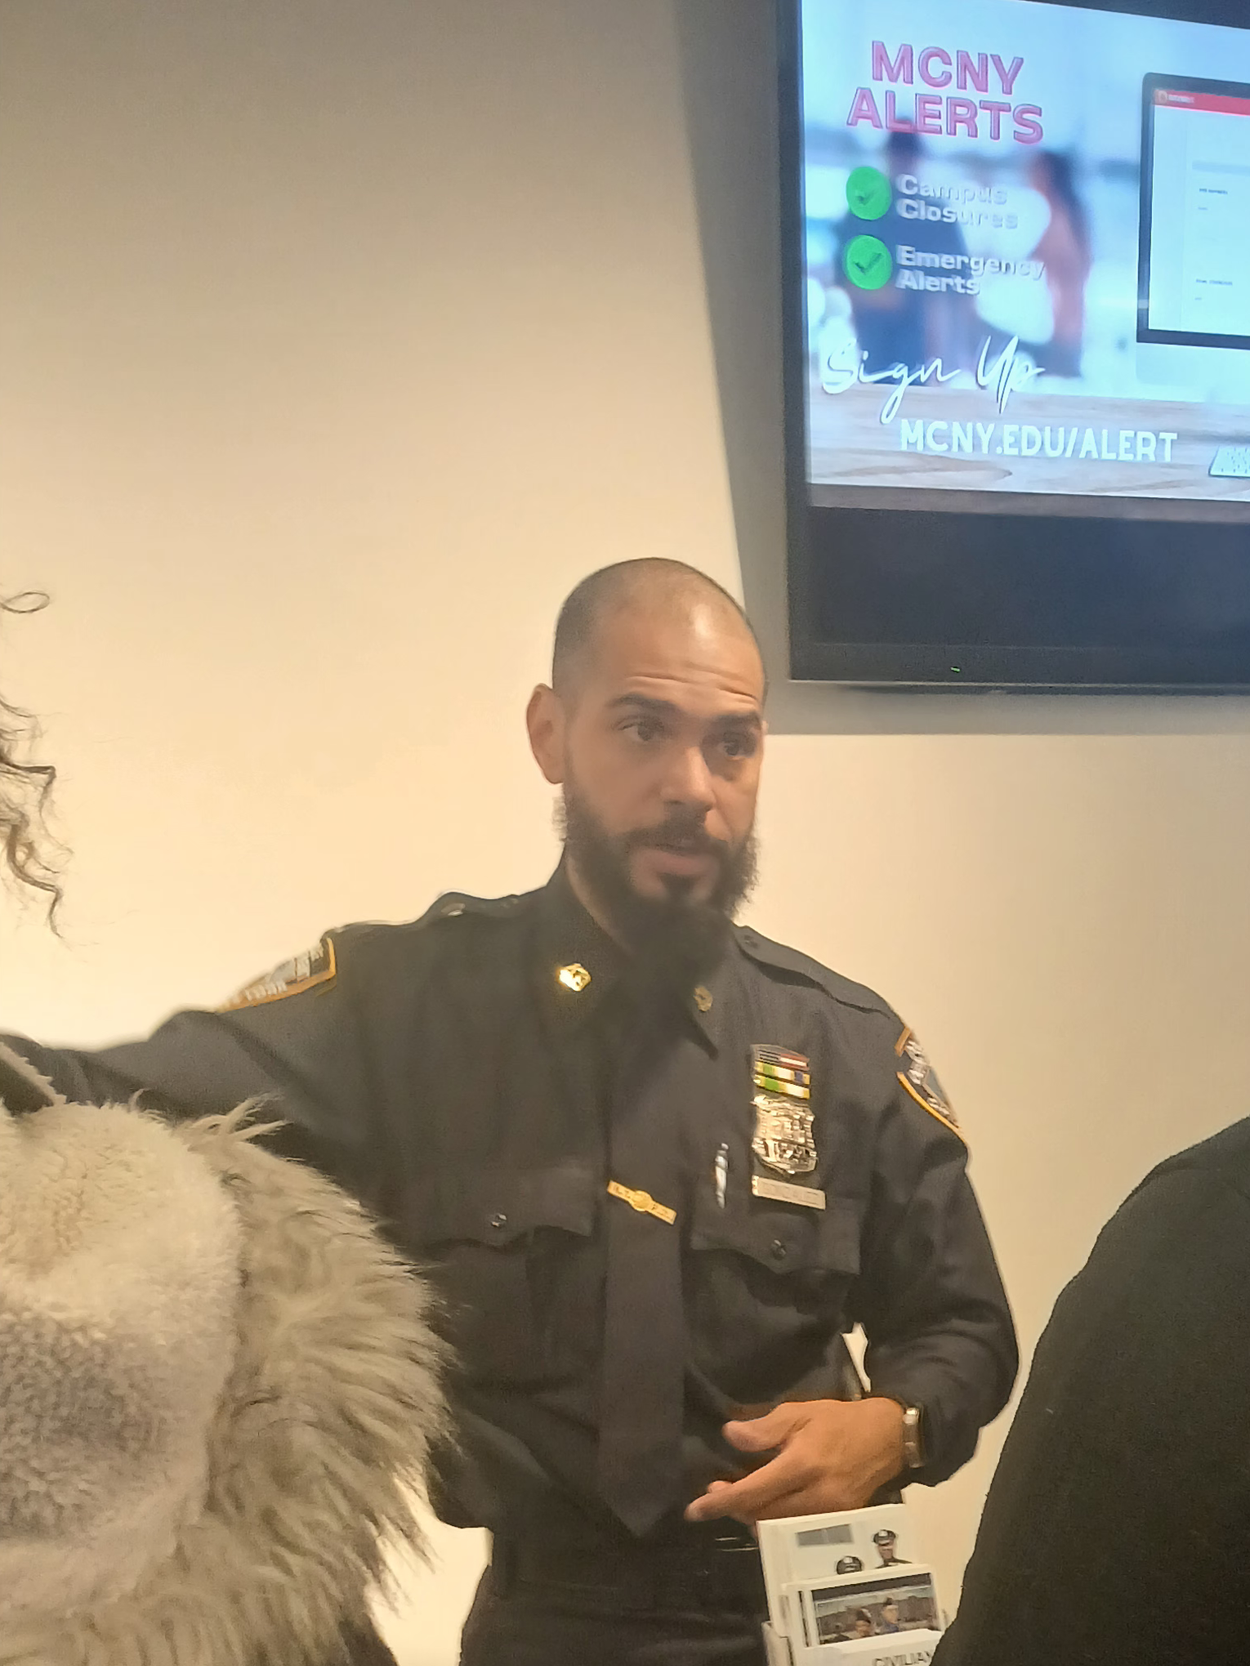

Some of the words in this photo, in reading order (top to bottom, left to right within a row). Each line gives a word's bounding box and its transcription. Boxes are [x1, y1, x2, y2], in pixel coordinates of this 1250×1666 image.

[871, 40, 1024, 96] MCNY
[847, 87, 1044, 145] ALERTS
[896, 173, 1008, 206] Campus
[896, 198, 1019, 230] Closures
[895, 268, 981, 296] Alerts
[896, 244, 1046, 281] Emergency
[822, 337, 962, 424] Sign
[976, 335, 1047, 415] Up
[899, 418, 1178, 463] MCNY.EDU/ALERT
